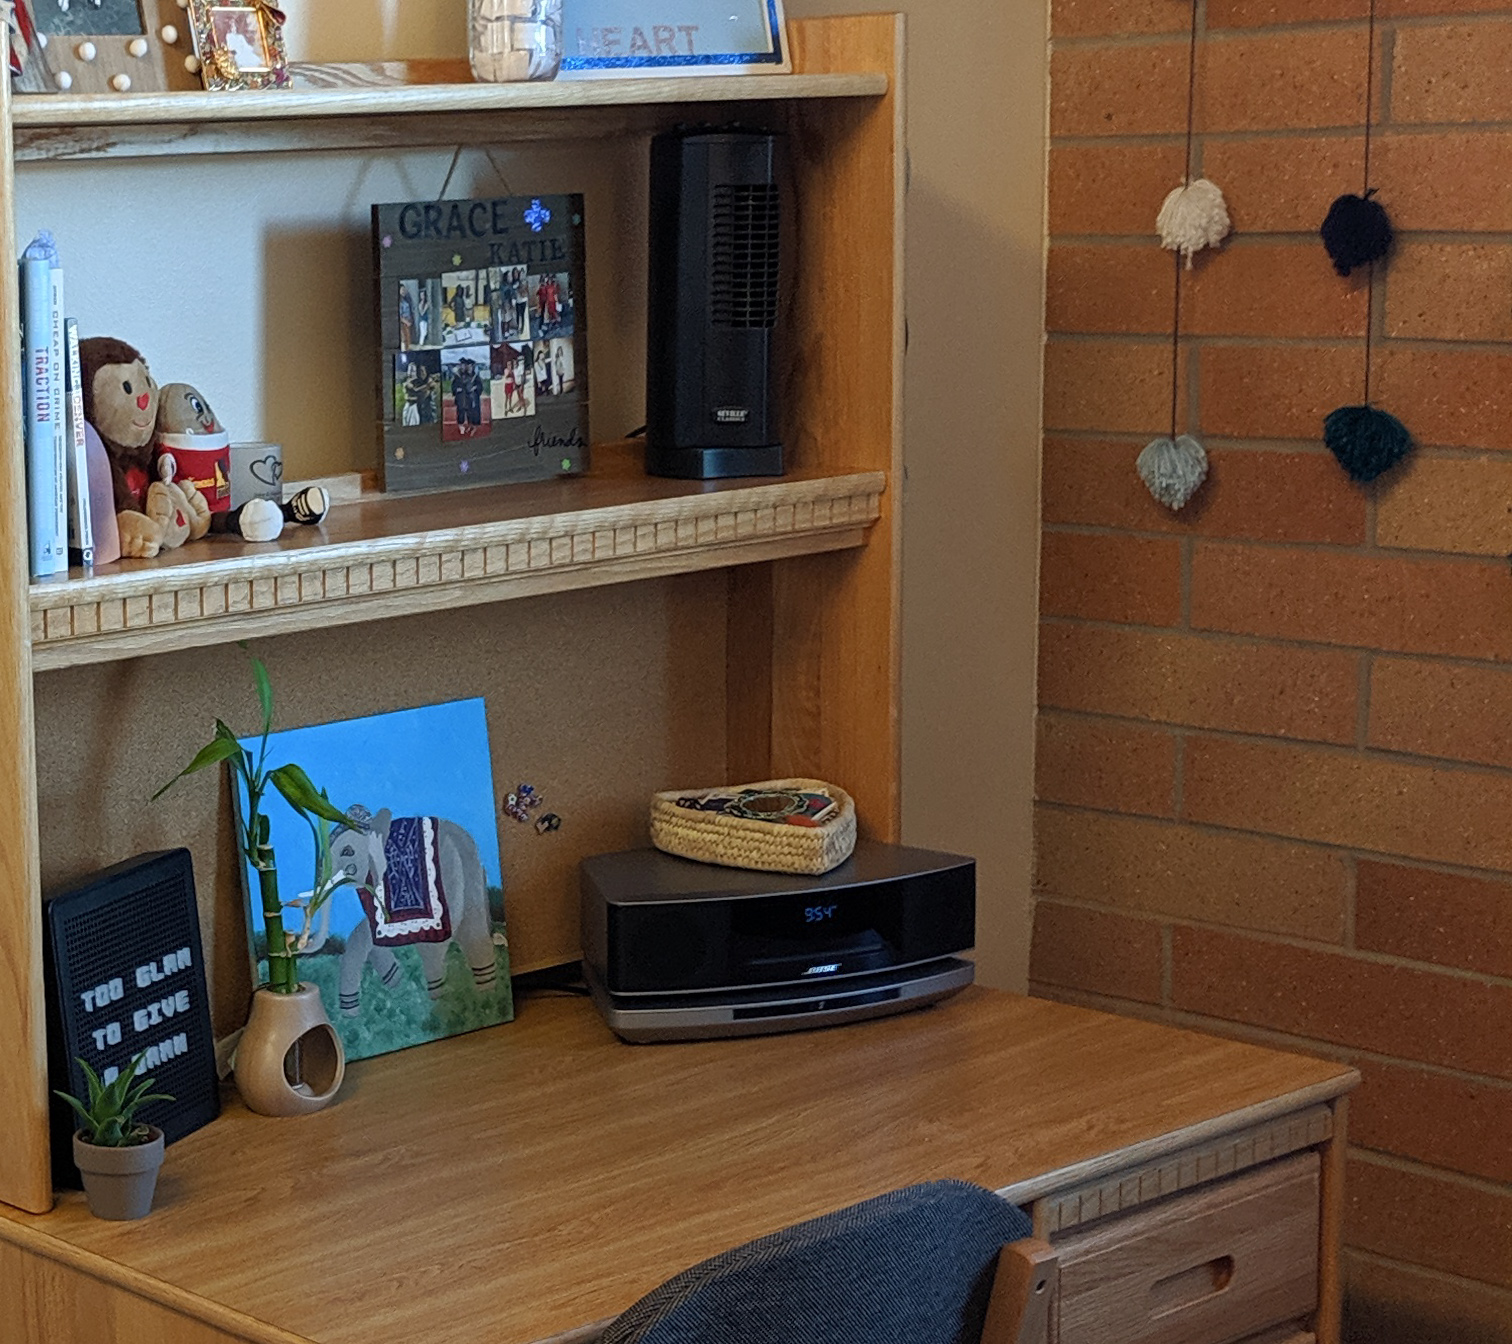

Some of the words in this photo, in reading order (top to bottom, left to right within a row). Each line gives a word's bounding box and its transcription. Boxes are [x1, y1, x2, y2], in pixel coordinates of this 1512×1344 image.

[398, 200, 510, 241] GRACE
[488, 237, 567, 266] KATIE
[51, 310, 60, 358] CHEAP
[34, 346, 51, 423] TRACTION
[52, 361, 61, 382] ON
[527, 423, 589, 457] friends
[80, 977, 125, 1012] TOO
[135, 946, 192, 988] GLAM
[92, 1021, 123, 1051] TO
[133, 989, 191, 1033] GIVE
